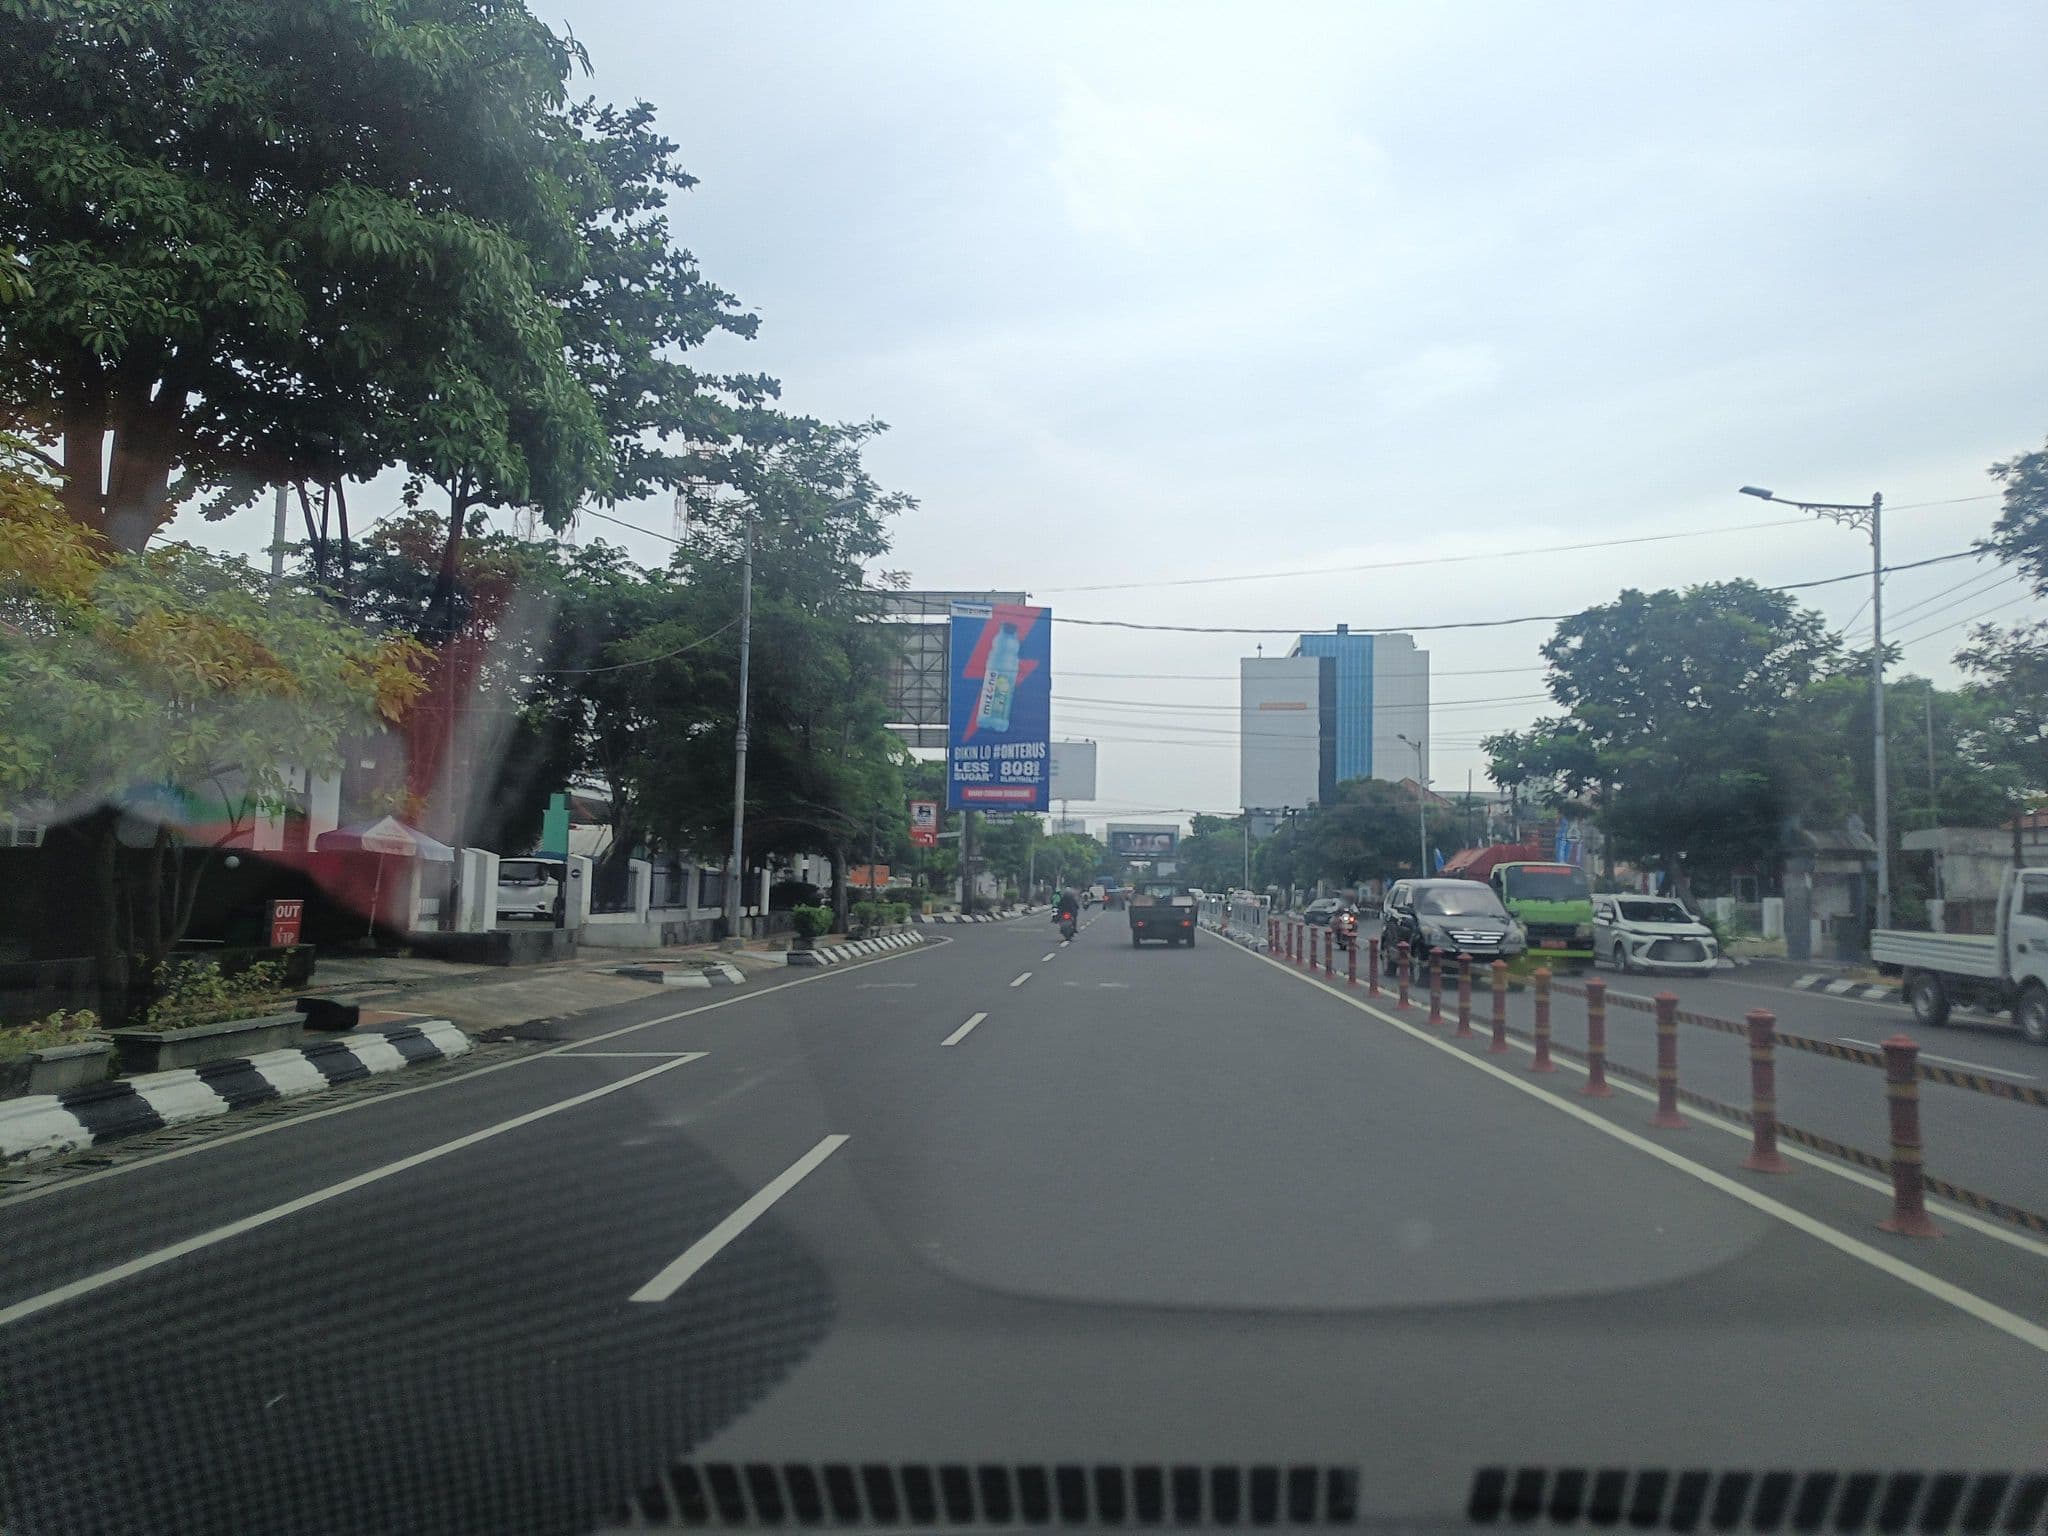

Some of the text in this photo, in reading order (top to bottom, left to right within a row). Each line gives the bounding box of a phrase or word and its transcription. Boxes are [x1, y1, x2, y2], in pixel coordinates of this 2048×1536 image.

[980, 745, 991, 760] LO
[993, 742, 1046, 760] #ONTERUS
[954, 761, 989, 772] LESS
[1000, 761, 1033, 776] 808
[275, 905, 301, 918] OUT
